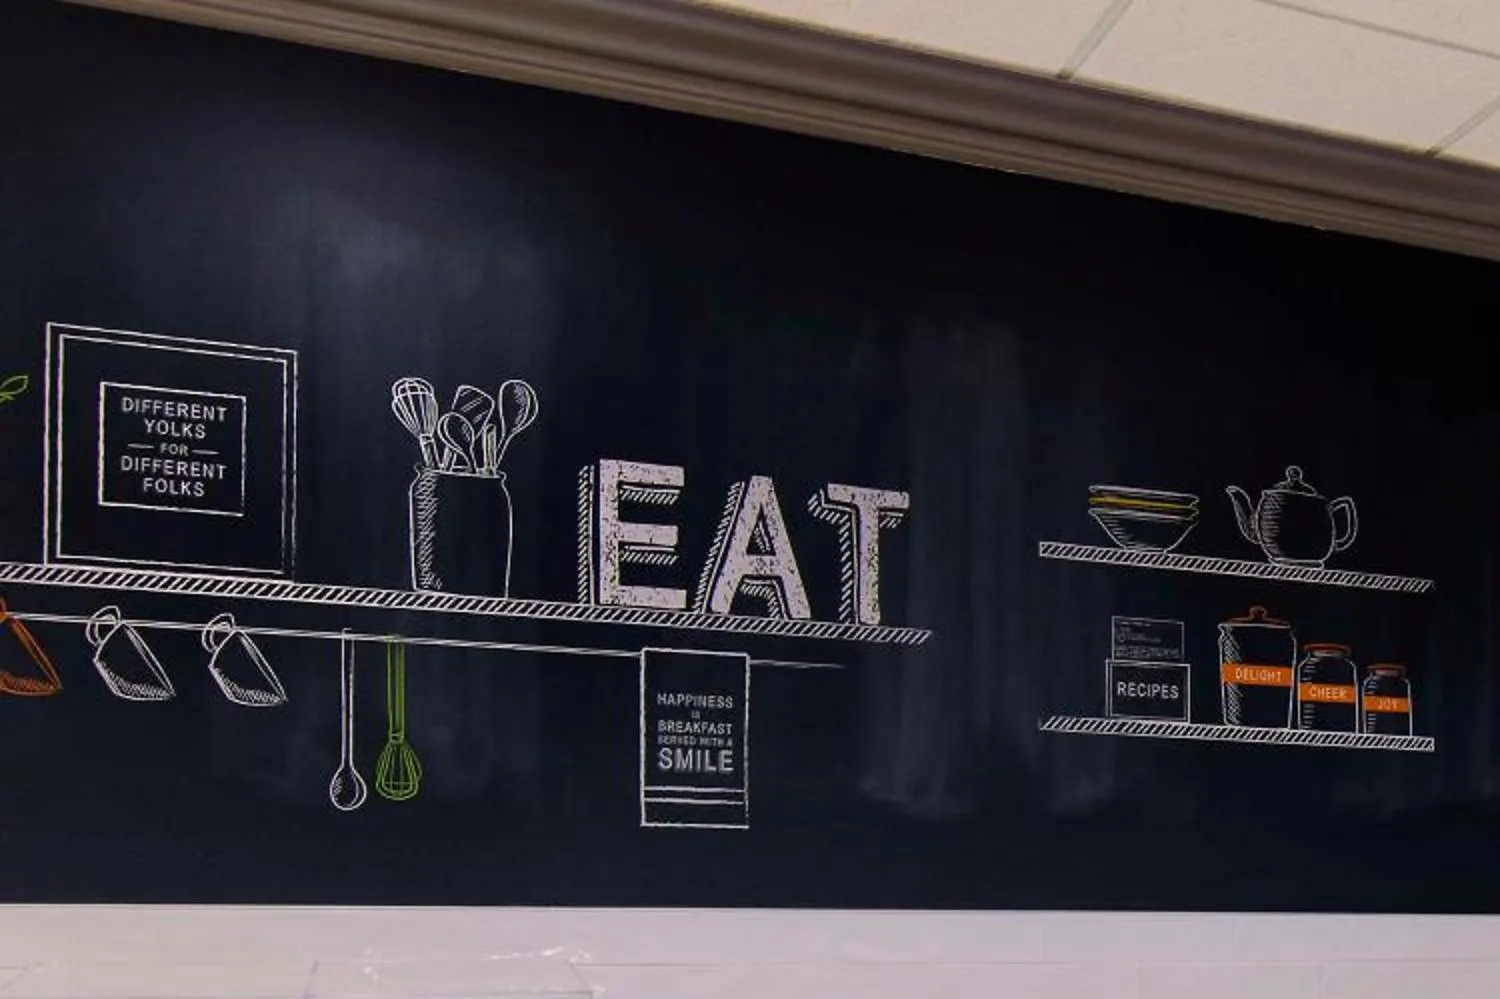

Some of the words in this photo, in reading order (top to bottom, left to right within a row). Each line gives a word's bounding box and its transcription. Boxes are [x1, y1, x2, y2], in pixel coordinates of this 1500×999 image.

[121, 397, 228, 422] DIFFERENT
[145, 419, 207, 439] YOLKS
[160, 443, 189, 456] FOR
[120, 455, 227, 480] DIFFERENT
[143, 478, 205, 497] FOLKS
[577, 458, 911, 626] EAT
[1235, 667, 1282, 683] DELIGHT
[1117, 681, 1179, 699] RECIPES
[1309, 686, 1348, 699] CHEER
[657, 693, 733, 709] HAPPINESS
[1377, 700, 1398, 710] JOY
[657, 720, 733, 735] BREAKFAST
[658, 747, 735, 773] SMILE
